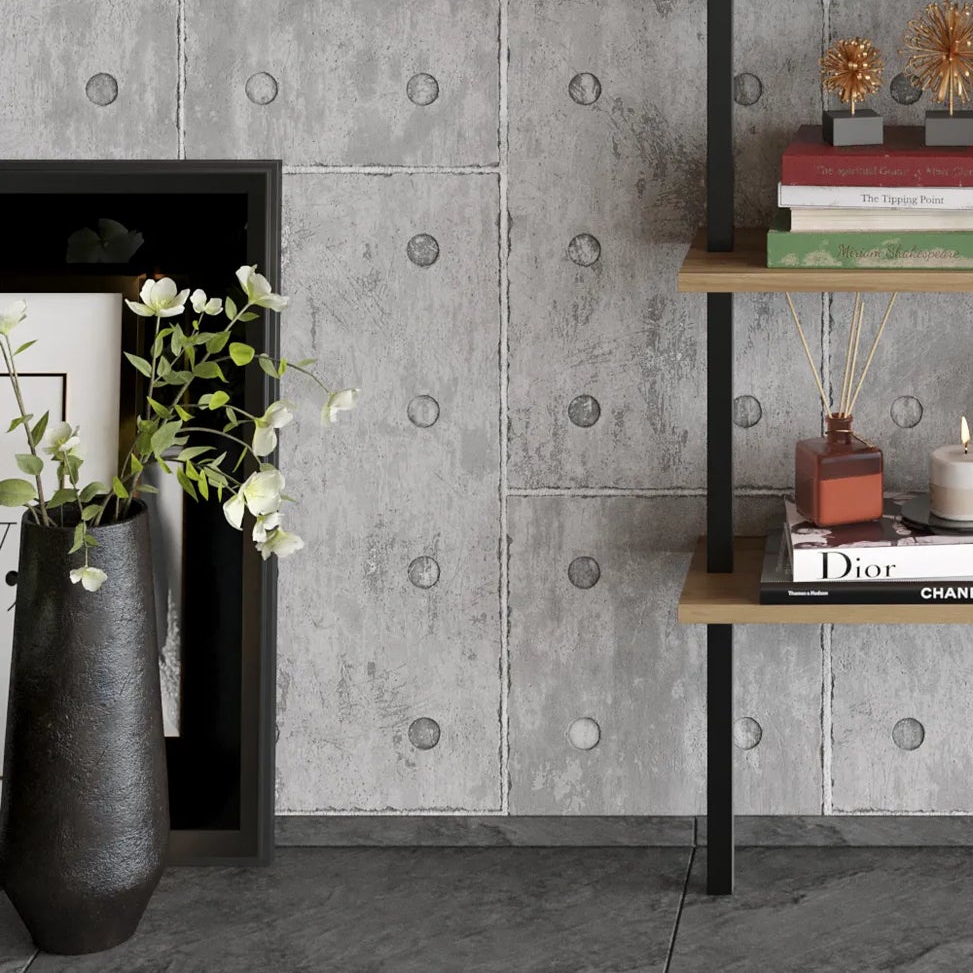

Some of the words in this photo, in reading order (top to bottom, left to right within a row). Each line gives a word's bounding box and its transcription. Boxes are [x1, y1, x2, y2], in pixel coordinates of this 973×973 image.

[860, 194, 880, 203] The
[882, 195, 918, 205] Tipping
[920, 195, 945, 204] Point
[817, 551, 897, 580] Dior
